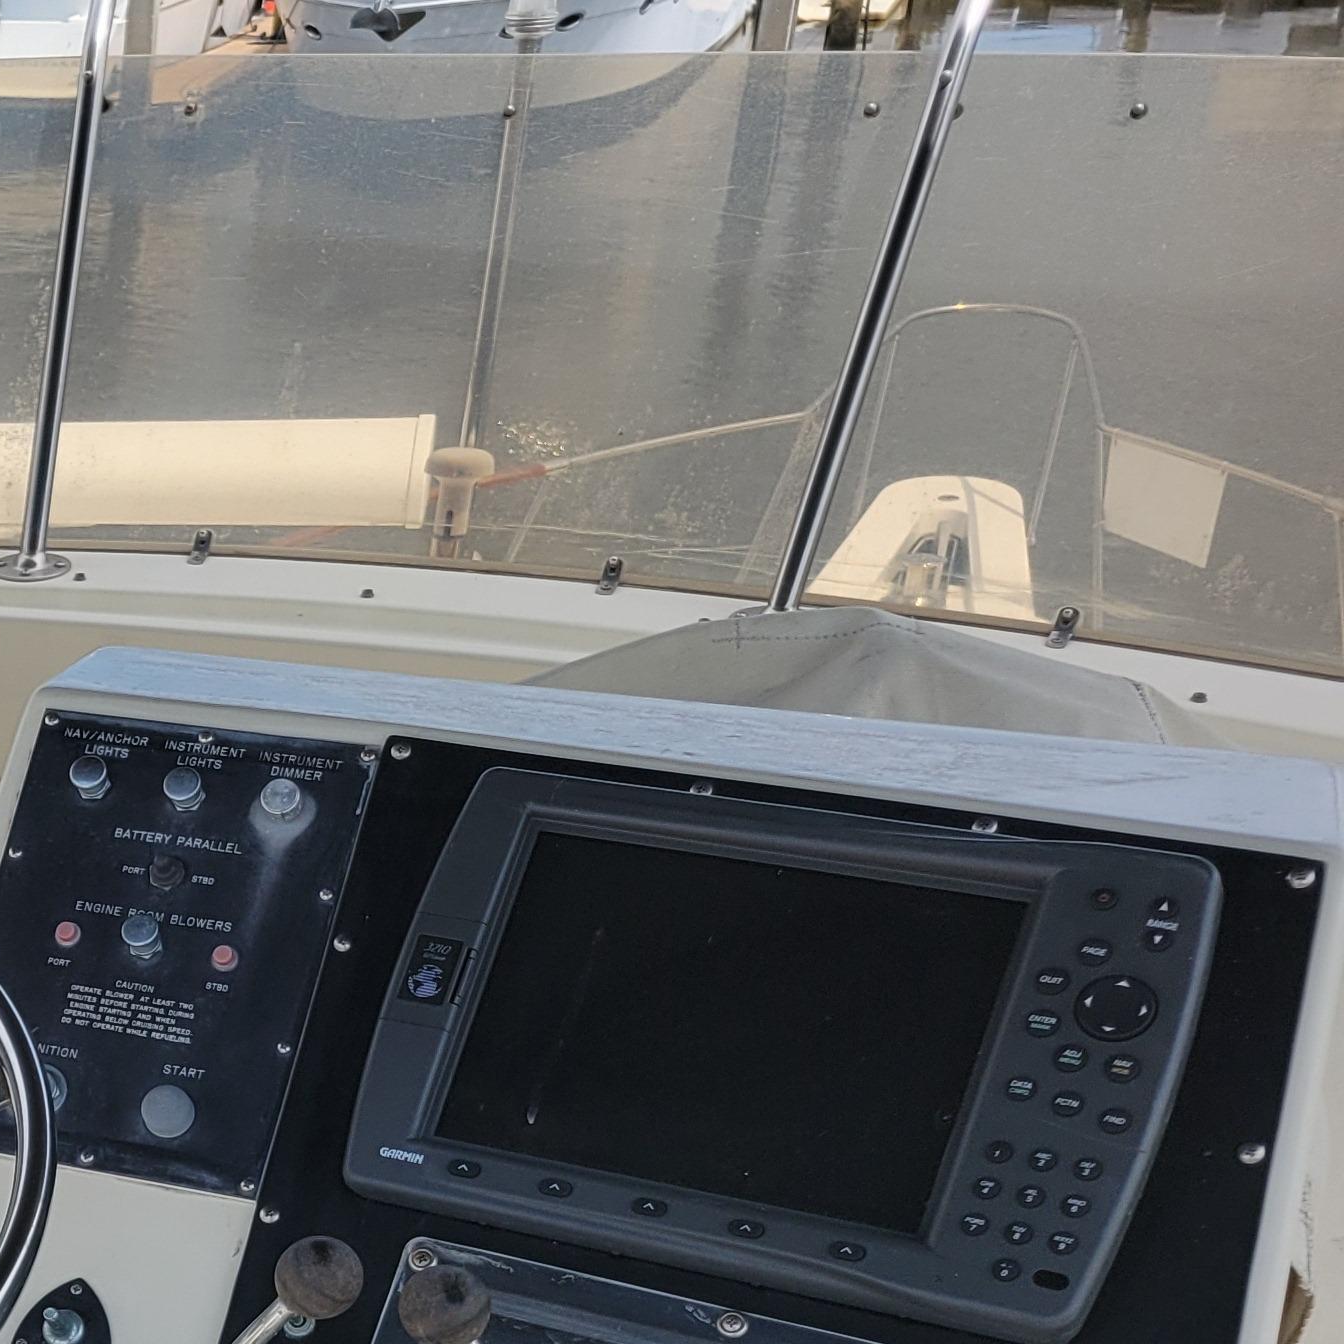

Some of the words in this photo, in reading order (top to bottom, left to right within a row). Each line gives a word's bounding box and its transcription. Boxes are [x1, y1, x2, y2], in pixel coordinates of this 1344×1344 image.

[64, 728, 149, 747] NAV/ANCHOR
[84, 744, 130, 758] LIGHTS
[164, 740, 246, 758] INSTRUMENT
[176, 755, 223, 769] LIGHTS
[258, 751, 344, 770] INSTRUMENT
[270, 766, 323, 781] DIMMER
[114, 828, 172, 844] BATTERY
[176, 836, 242, 854] PARALLEL
[122, 865, 146, 875] PORT
[191, 875, 215, 885] STBD
[75, 900, 123, 917] ENGINE
[170, 914, 232, 933] BLOWERS
[47, 957, 71, 967] PORT
[115, 980, 155, 993] CAUTION
[205, 982, 229, 993] STBD
[1039, 975, 1064, 985] QUIT
[71, 984, 102, 995] OPERATE
[105, 990, 134, 1000] BLOWER
[152, 998, 176, 1007] LEAST
[179, 1002, 194, 1010] TWO
[100, 998, 128, 1009] BEFORE
[63, 1008, 101, 1020] OPERATING
[105, 1016, 129, 1025] BELOW
[99, 1007, 132, 1017] STARTING
[155, 1016, 176, 1025] WHEN
[61, 1016, 72, 1024] DO
[92, 1022, 123, 1033] OPERATE
[37, 1043, 79, 1059] NITION
[162, 1063, 206, 1080] START
[380, 1147, 424, 1165] GARMIN
